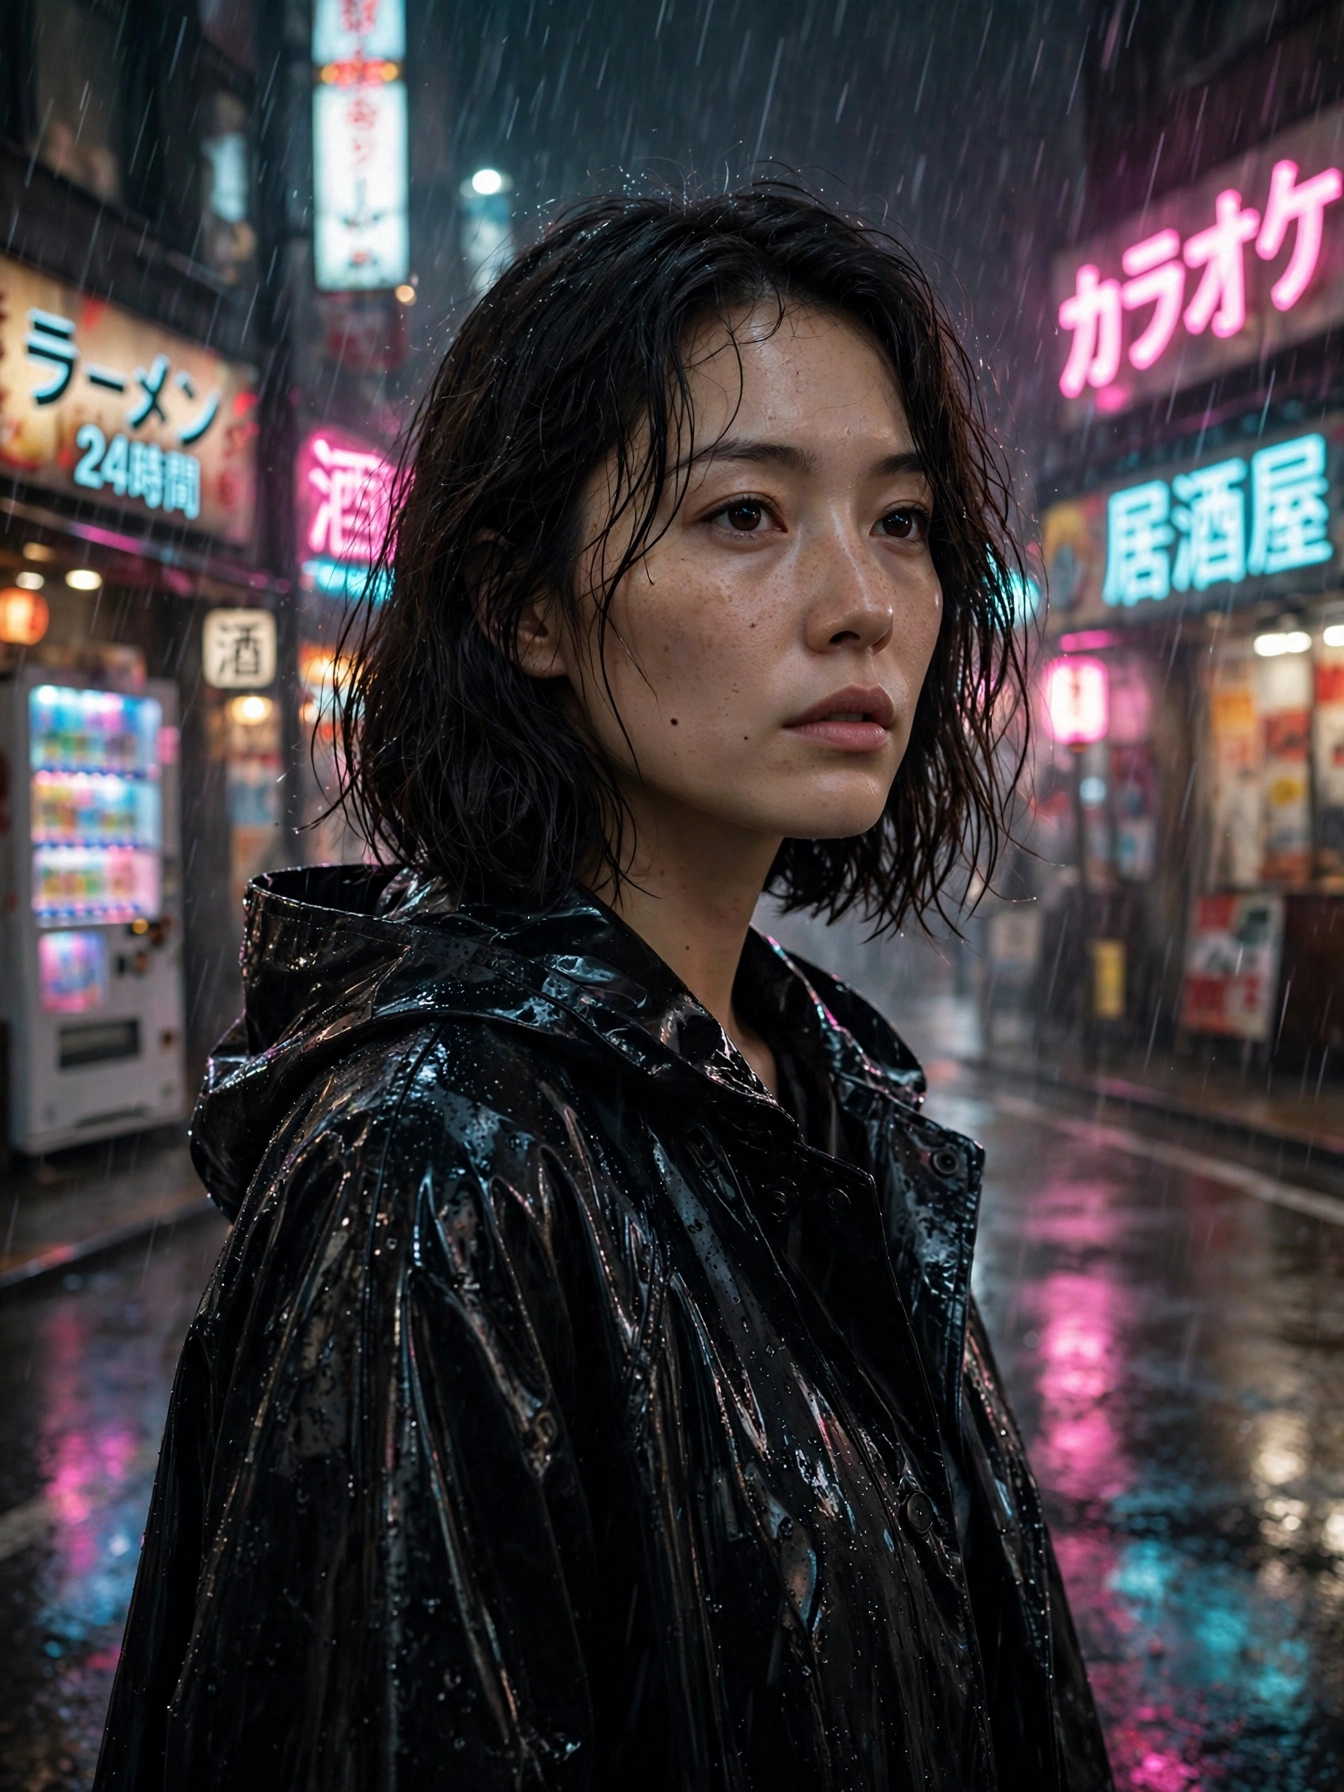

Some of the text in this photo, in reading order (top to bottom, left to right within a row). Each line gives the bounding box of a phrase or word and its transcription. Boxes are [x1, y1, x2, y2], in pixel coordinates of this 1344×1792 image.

[1059, 159, 1343, 398] カラオケ
[25, 307, 220, 444] ラーメン
[74, 424, 201, 519] 24時間
[1103, 433, 1333, 607] 居酒屋
[217, 620, 263, 677] 酒
